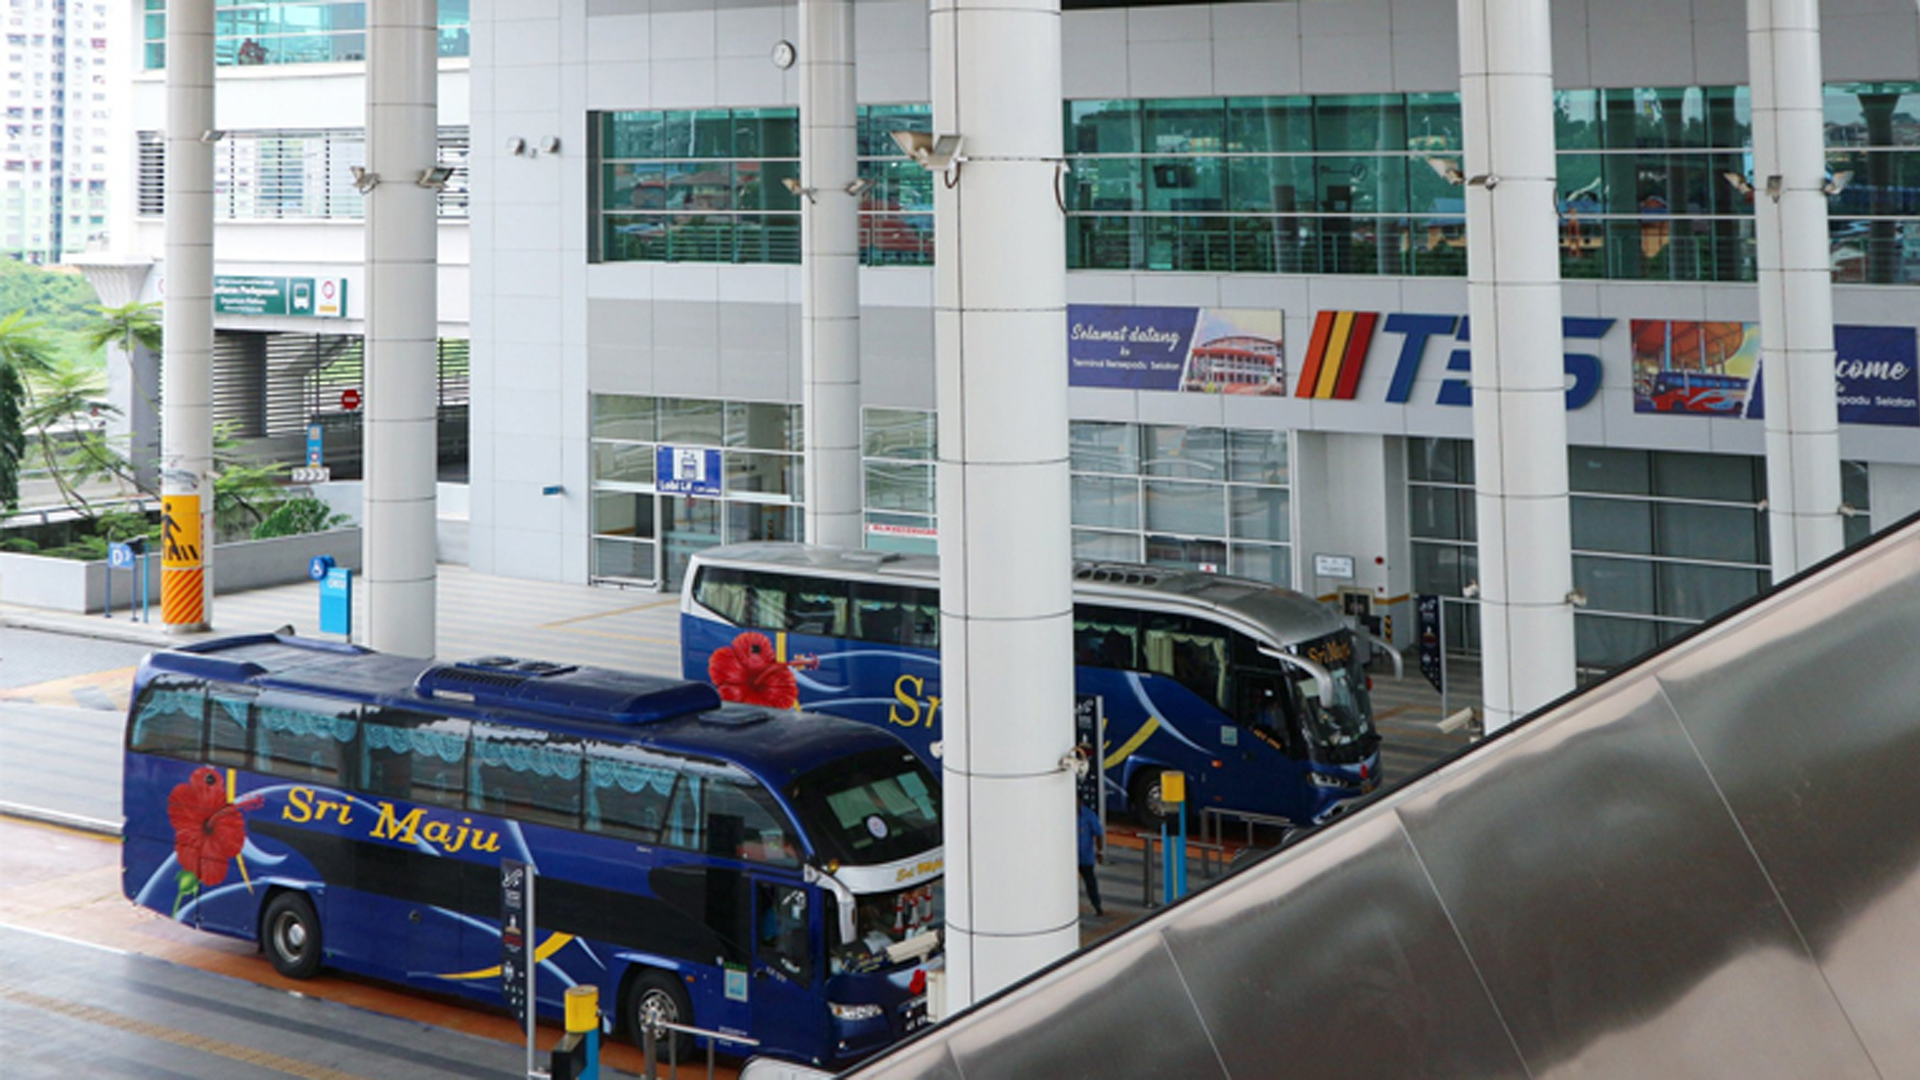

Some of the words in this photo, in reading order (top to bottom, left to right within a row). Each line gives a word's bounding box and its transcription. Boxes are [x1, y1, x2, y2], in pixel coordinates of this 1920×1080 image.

[1071, 324, 1128, 341] Selamat
[1129, 326, 1181, 352] datang
[1836, 361, 1911, 380] come
[889, 675, 942, 728] Sr
[282, 786, 353, 825] Sri
[369, 801, 501, 852] Maju
